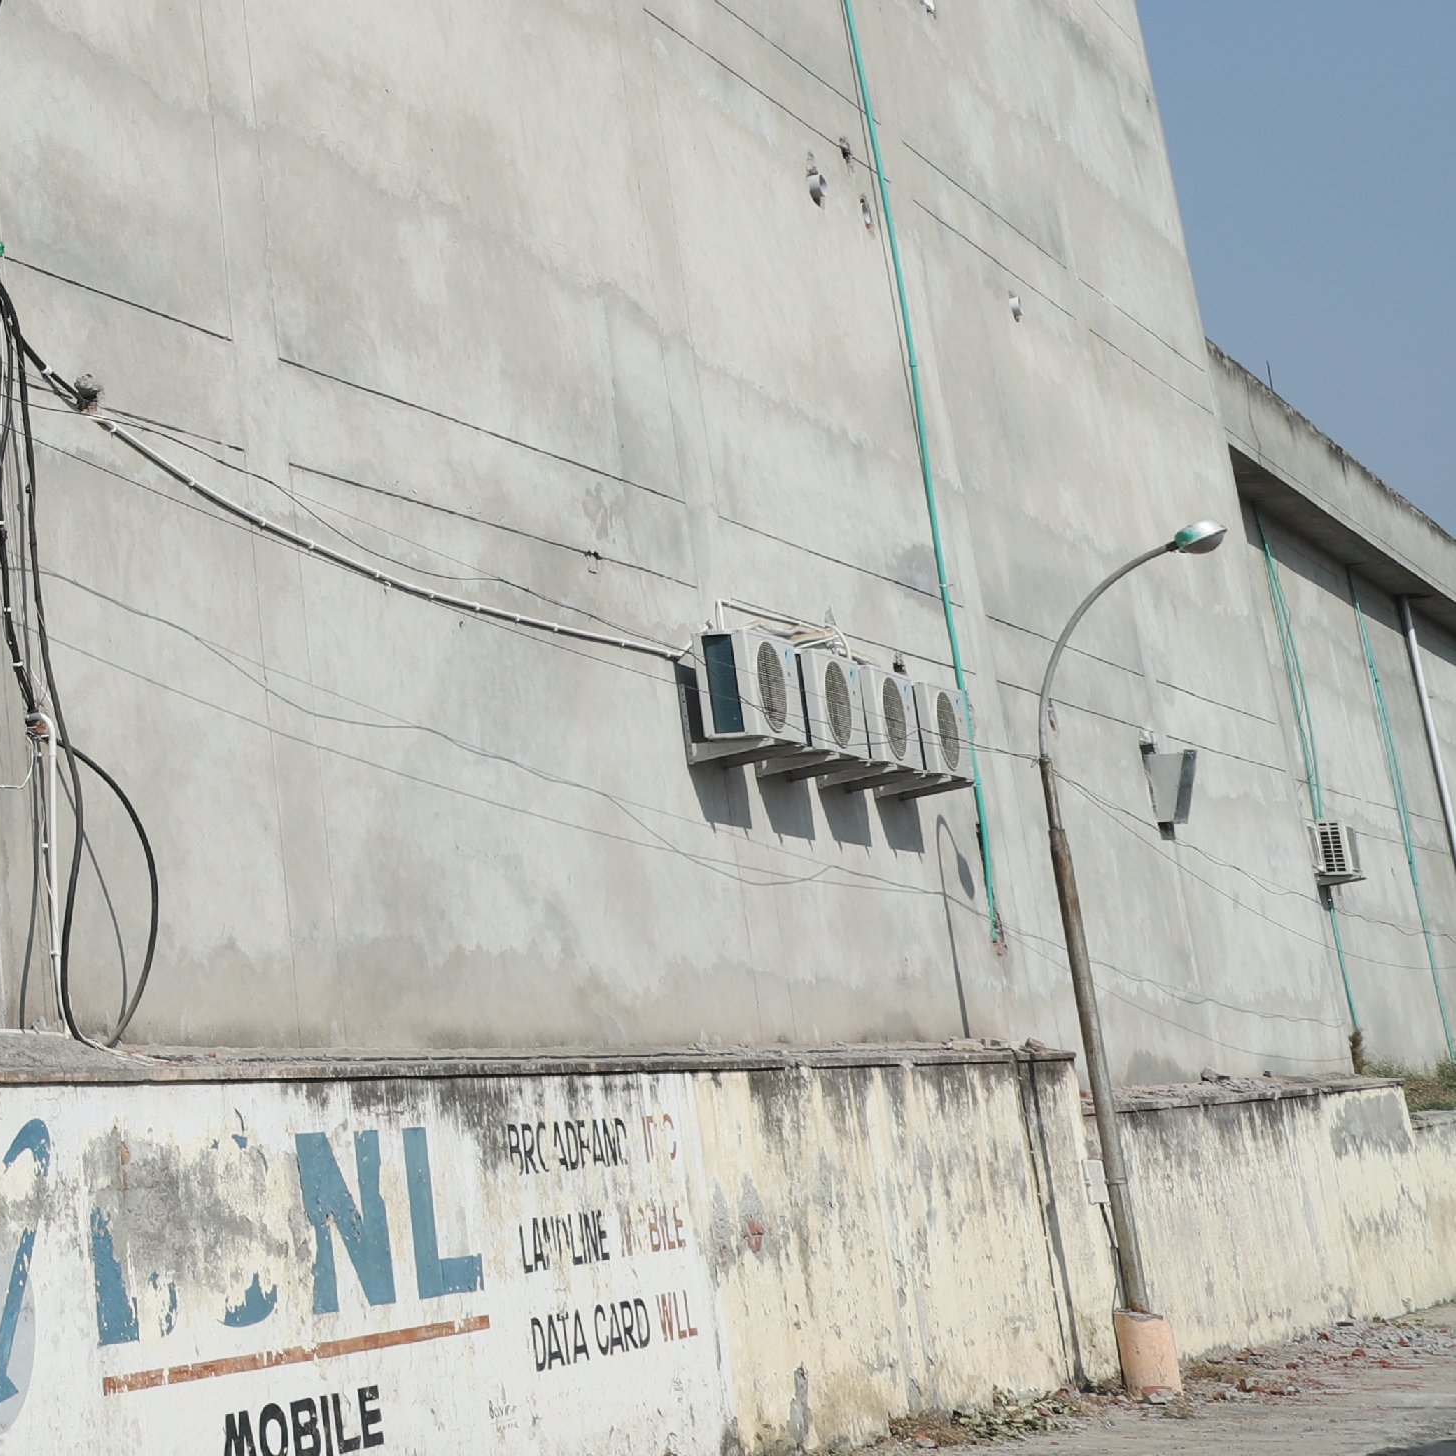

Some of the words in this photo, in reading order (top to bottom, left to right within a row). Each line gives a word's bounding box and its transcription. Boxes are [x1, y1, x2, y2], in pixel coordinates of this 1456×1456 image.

[530, 1308, 590, 1373] DATA
[593, 1297, 651, 1356] CARD
[655, 1289, 699, 1343] WLL
[224, 1385, 385, 1456] MOBILE
